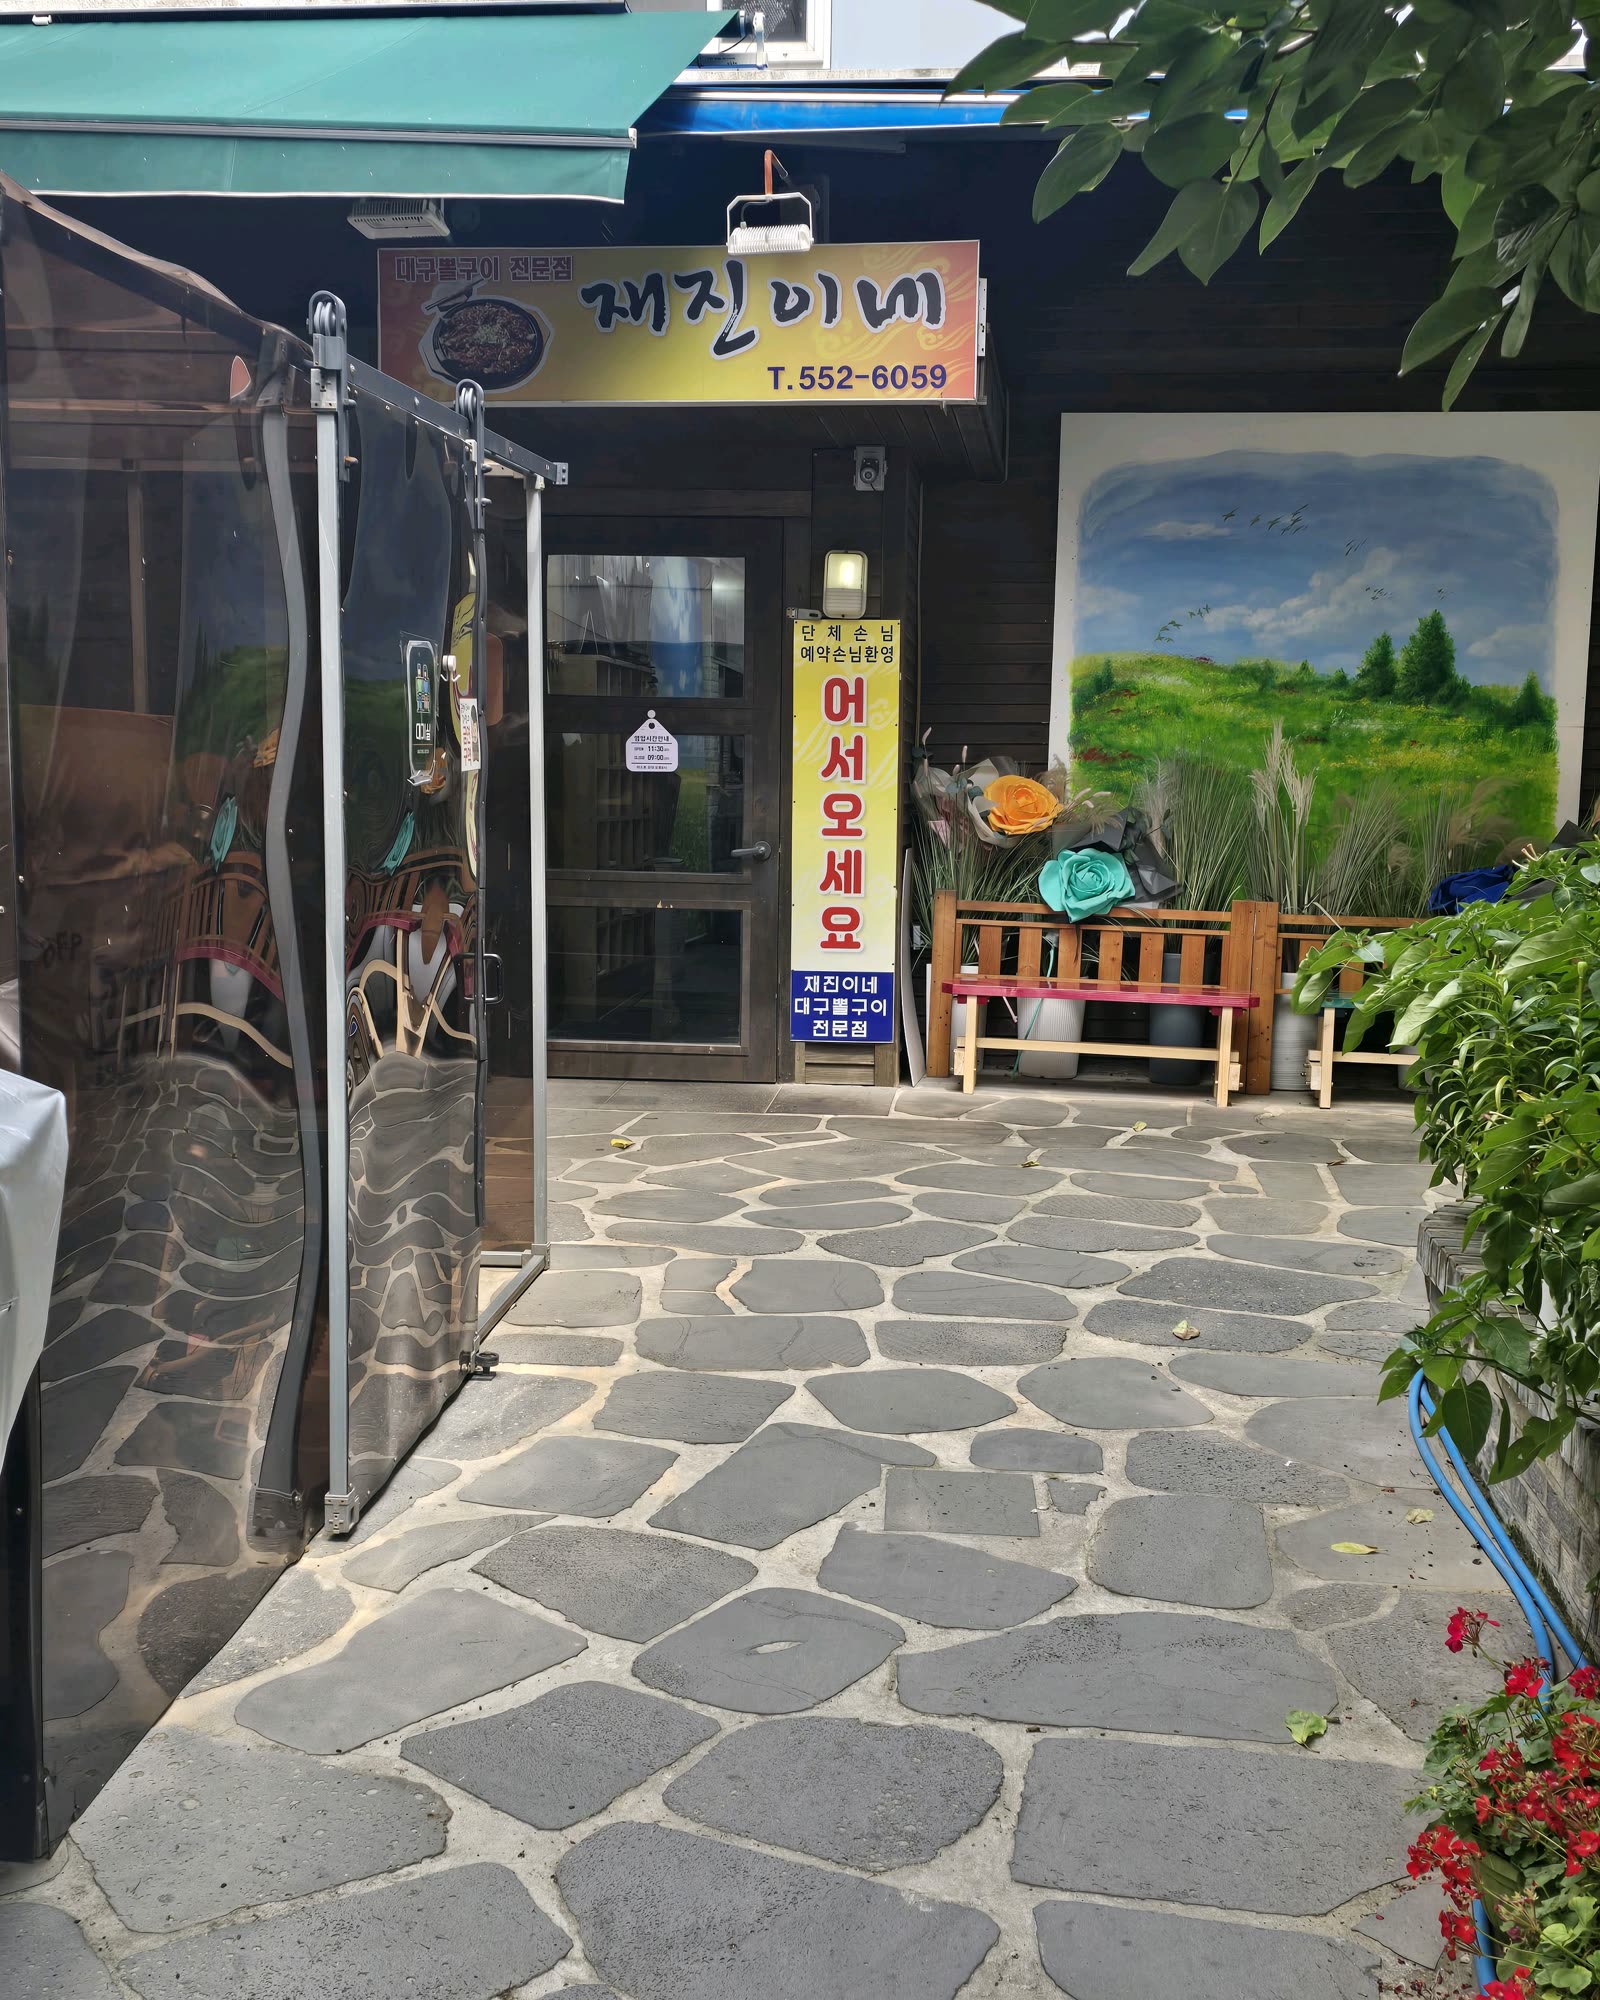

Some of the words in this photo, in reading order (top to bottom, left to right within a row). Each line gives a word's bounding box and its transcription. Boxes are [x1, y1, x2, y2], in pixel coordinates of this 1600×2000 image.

[395, 255, 500, 282] 대구뽈구이
[509, 255, 573, 281] 전문점
[578, 257, 946, 360] 재진이네
[800, 645, 894, 663] 예약손님환영
[819, 675, 867, 951] 어서오세요
[804, 975, 878, 994] 재진이네
[794, 997, 887, 1017] 대구뽈구이
[812, 1019, 868, 1038] 전문점
